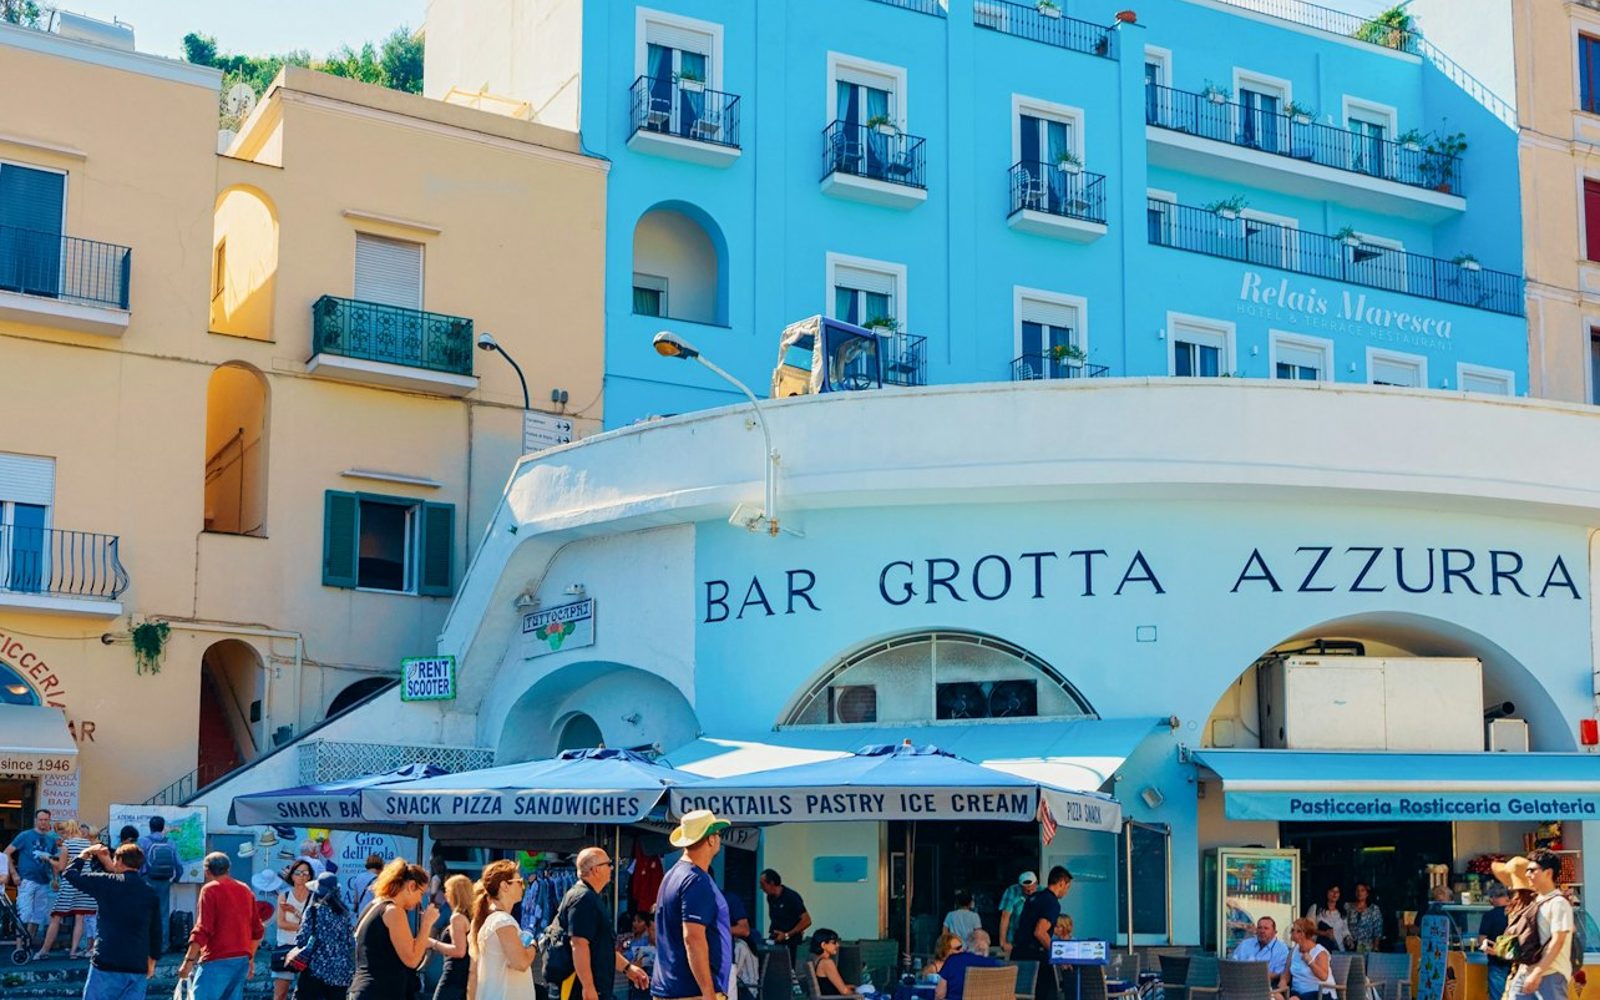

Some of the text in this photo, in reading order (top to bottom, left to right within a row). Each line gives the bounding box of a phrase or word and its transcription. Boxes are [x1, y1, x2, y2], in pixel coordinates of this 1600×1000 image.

[1240, 271, 1452, 339] Relais Maresca
[1236, 303, 1281, 321] HOTEL
[1304, 314, 1365, 335] TERRACE
[1370, 328, 1453, 350] RESTAURANT
[703, 546, 1582, 623] BAR GROTTA AZZURRA
[526, 602, 589, 628] TUTTOCAPRI
[419, 661, 449, 678] RENT
[408, 679, 449, 696] SCOOTER
[1, 758, 70, 771] since 1946
[43, 789, 76, 797] SNACK
[277, 801, 331, 818] SNACK
[386, 796, 639, 816] SNACK PIZZA SANDWICHES
[681, 793, 1028, 815] COCKTAILS PASTRY ICE CREAM
[1067, 801, 1102, 824] PIZZA SNACK
[1290, 798, 1595, 814] Pasticceria Rosticceria Gelateria
[355, 831, 384, 846] Giro
